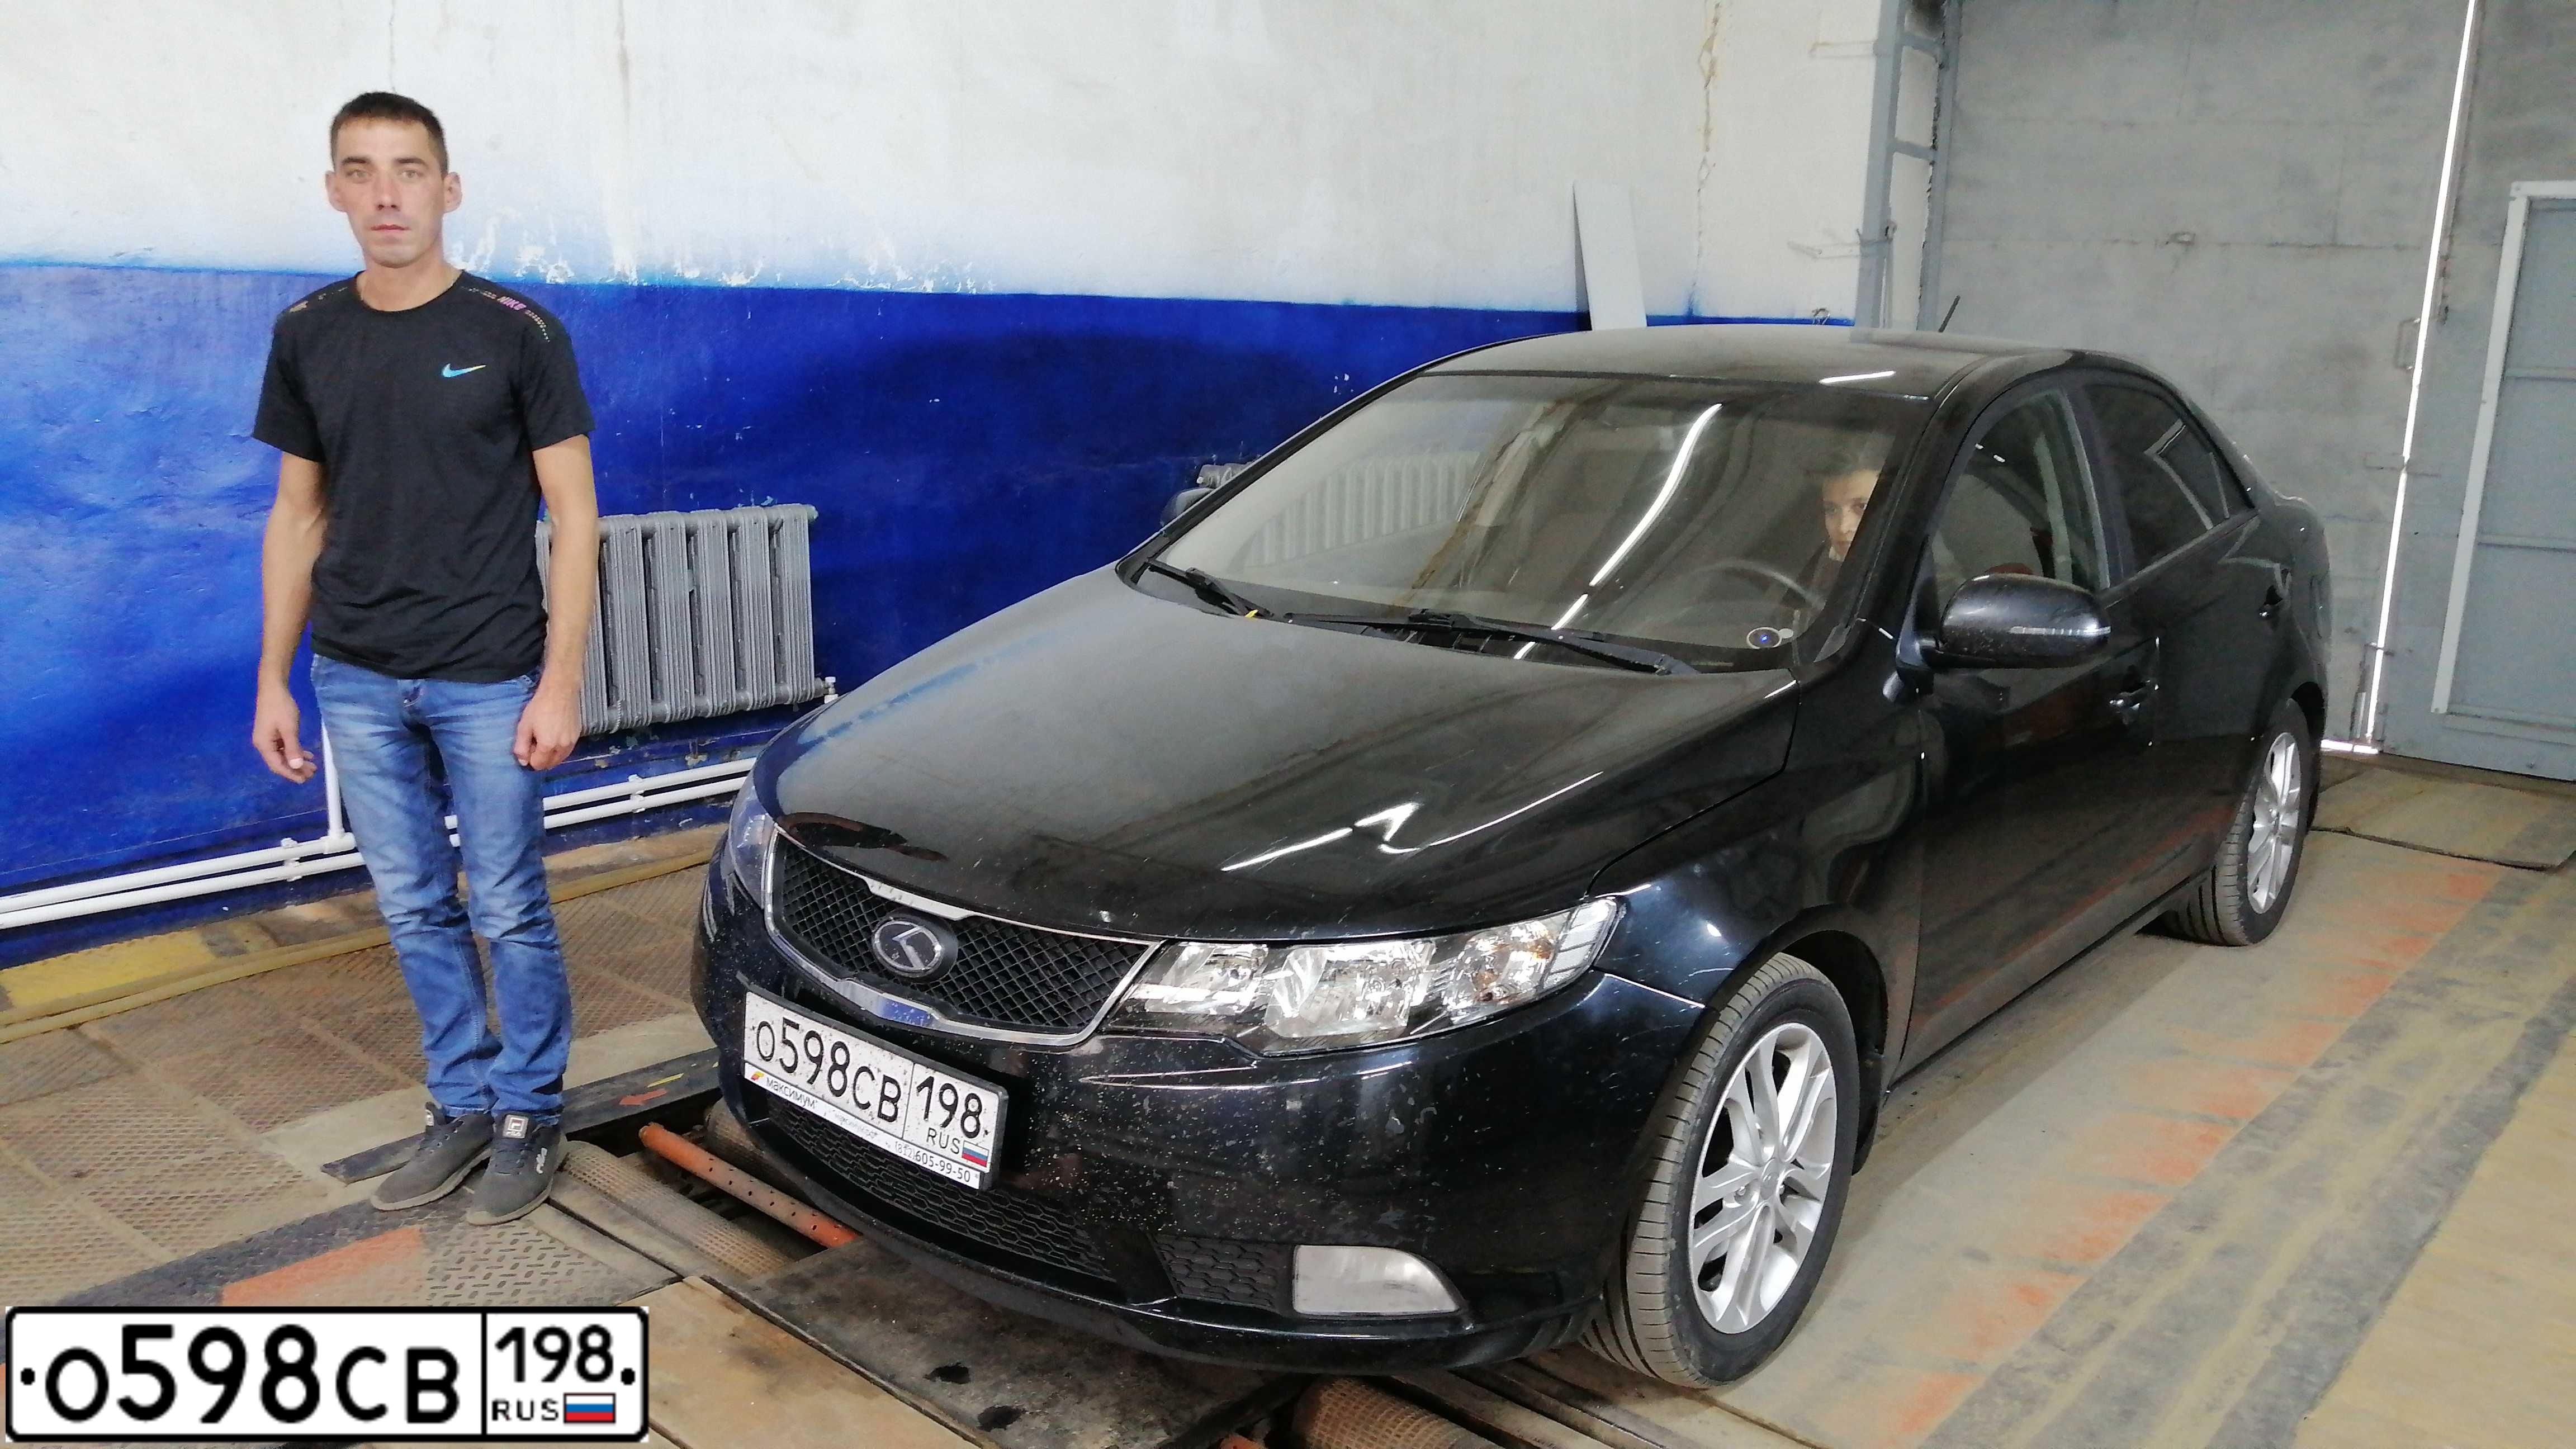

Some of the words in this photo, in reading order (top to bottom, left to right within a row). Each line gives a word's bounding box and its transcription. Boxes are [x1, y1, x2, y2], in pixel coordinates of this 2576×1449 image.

[497, 296, 527, 310] NIKE
[916, 1076, 982, 1139] 198
[926, 1127, 960, 1154] RUS
